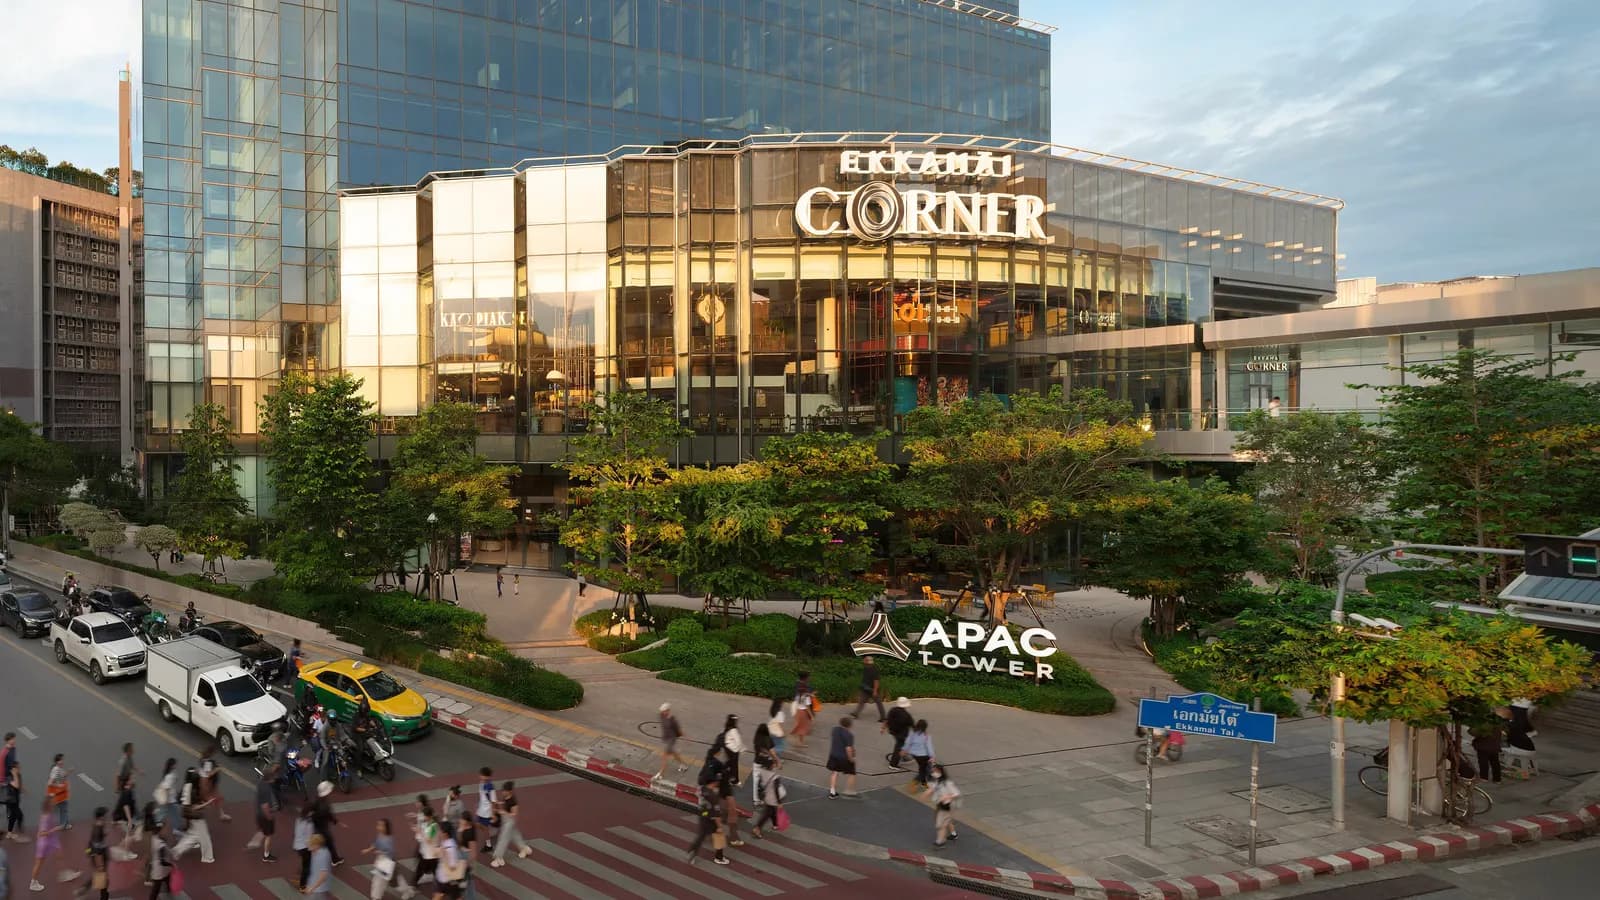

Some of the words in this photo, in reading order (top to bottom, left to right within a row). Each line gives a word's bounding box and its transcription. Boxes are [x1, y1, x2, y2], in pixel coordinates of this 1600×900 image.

[795, 181, 1048, 241] CORNER
[477, 311, 506, 326] PIAK
[919, 619, 1057, 657] APAC
[918, 651, 1054, 680] TOWER
[1173, 708, 1240, 727] เอกมัยใต้
[1175, 722, 1216, 734] Ekkamai
[1221, 727, 1235, 737] Tai
